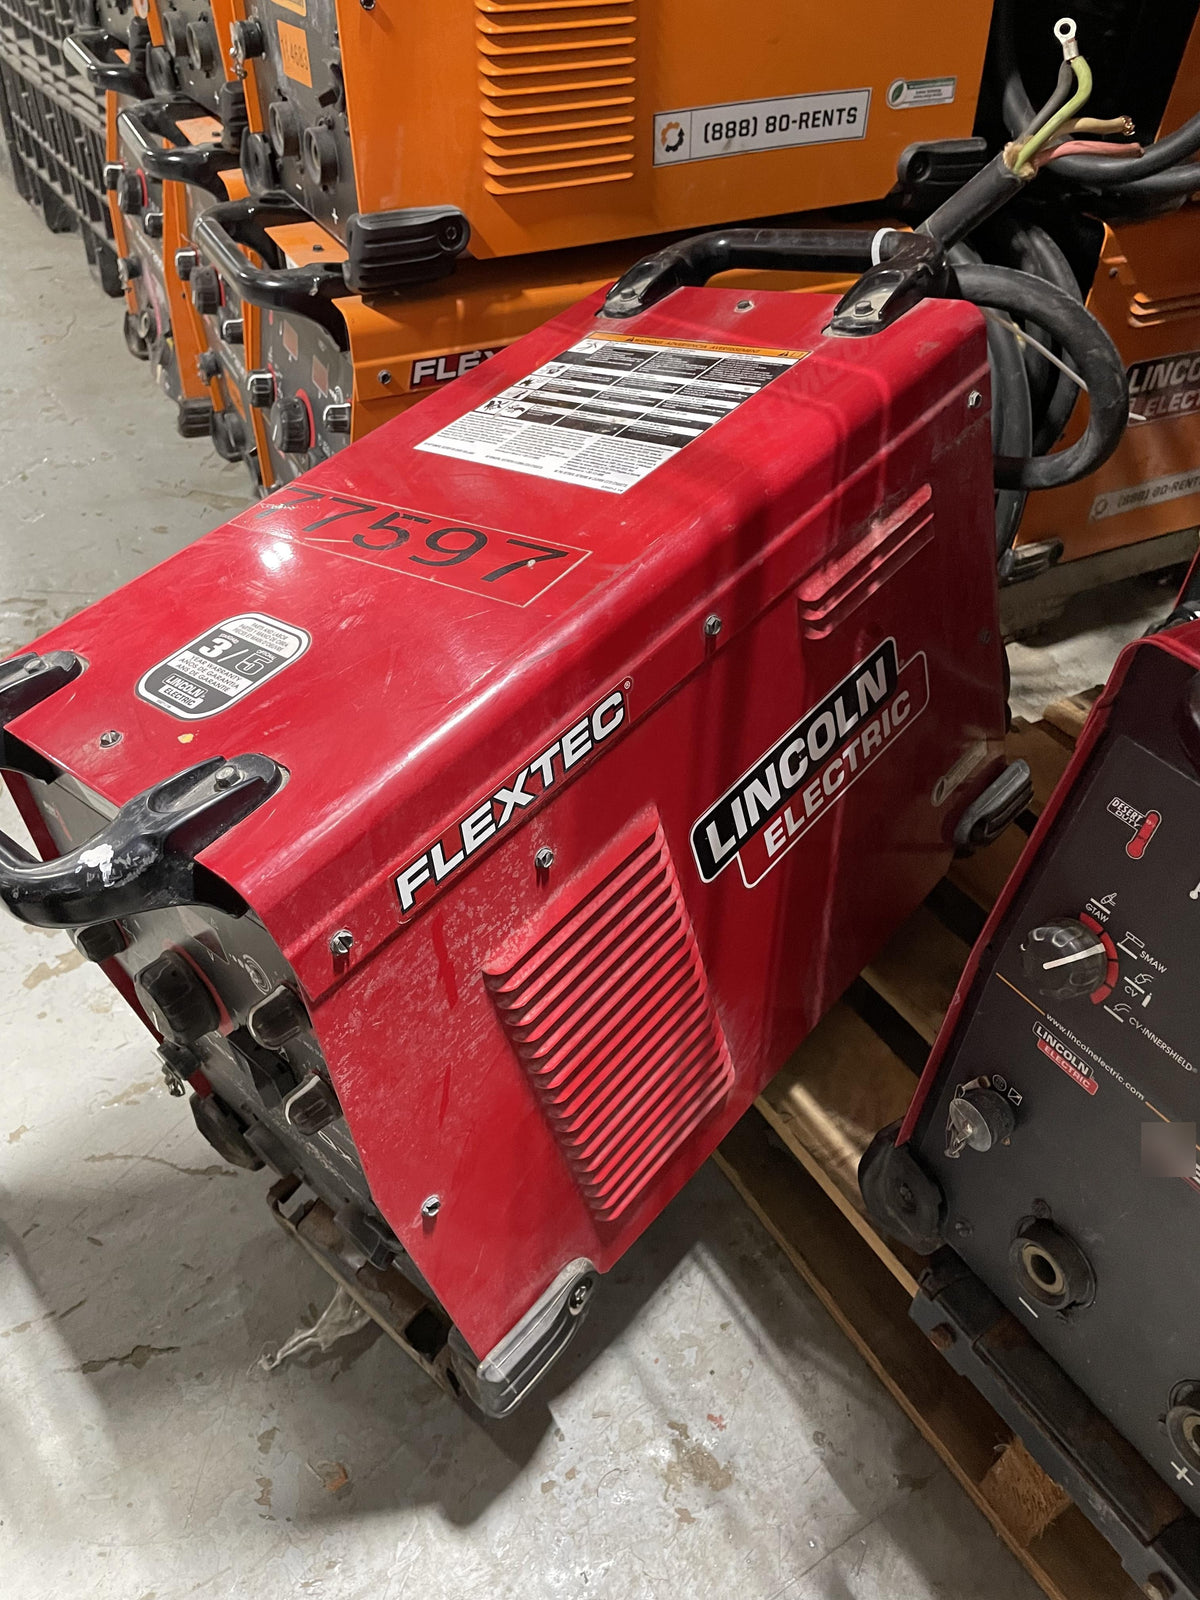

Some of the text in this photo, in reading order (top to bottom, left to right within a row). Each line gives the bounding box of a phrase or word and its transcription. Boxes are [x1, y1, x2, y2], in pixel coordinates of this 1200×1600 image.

[704, 106, 858, 144] (888) 80-RENTS
[412, 350, 495, 384] FLE
[254, 486, 570, 583] 77597
[176, 664, 190, 672] ANS
[198, 673, 231, 692] GARANTIE
[191, 655, 242, 682] YEAR WARRANTY
[163, 687, 197, 706] ELECTRIC
[164, 675, 205, 698] LINCOLN
[705, 655, 889, 864] LINCOLN
[762, 689, 912, 859] ELECTRIC
[1112, 799, 1144, 822] DESERT
[1115, 809, 1143, 828] DUTY
[1085, 902, 1109, 923] GTAW
[1139, 950, 1168, 974] SMAW
[1124, 985, 1139, 998] CV
[1036, 1025, 1089, 1076] LINCOLN
[1046, 1013, 1145, 1101] www.lincolnelectric.com
[1044, 1045, 1092, 1089] ELECTRIC
